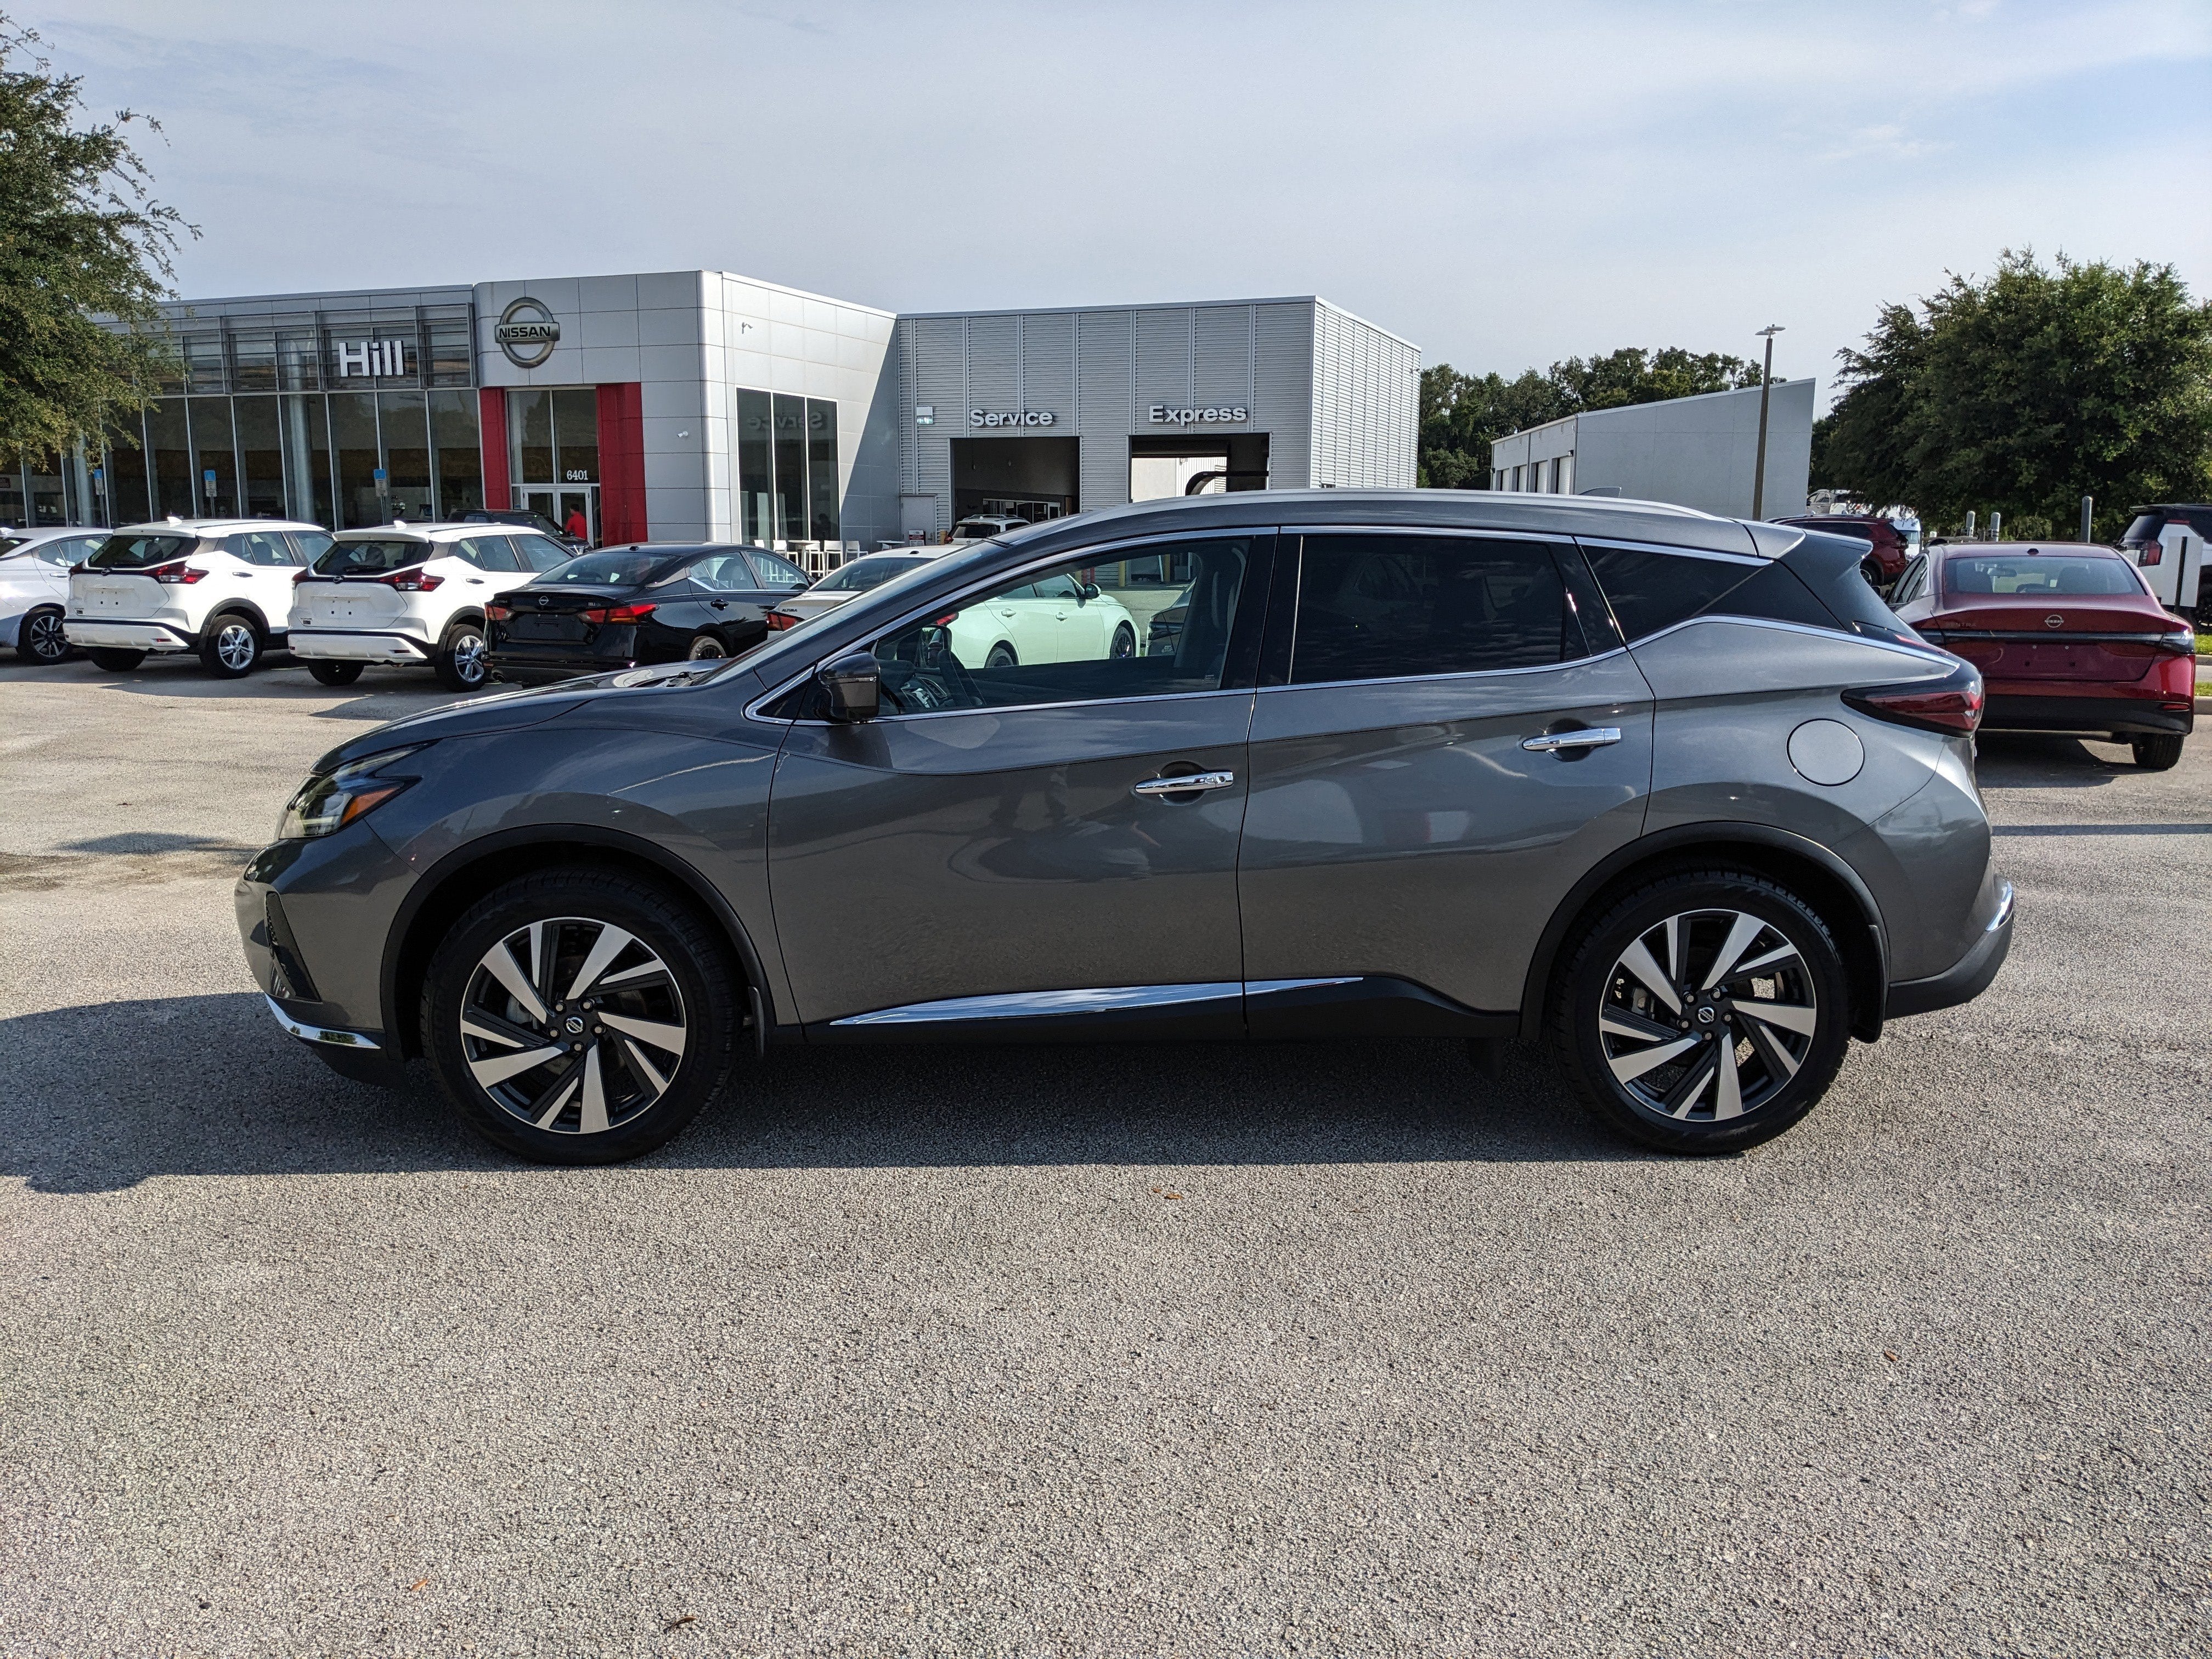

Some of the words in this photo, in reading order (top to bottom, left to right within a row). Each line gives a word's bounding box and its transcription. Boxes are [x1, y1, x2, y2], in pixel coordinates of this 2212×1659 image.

[499, 326, 550, 338] NISSAN
[338, 340, 405, 377] Hill
[969, 409, 1053, 426] Service
[1149, 405, 1247, 426] Express
[567, 470, 588, 480] 6401
